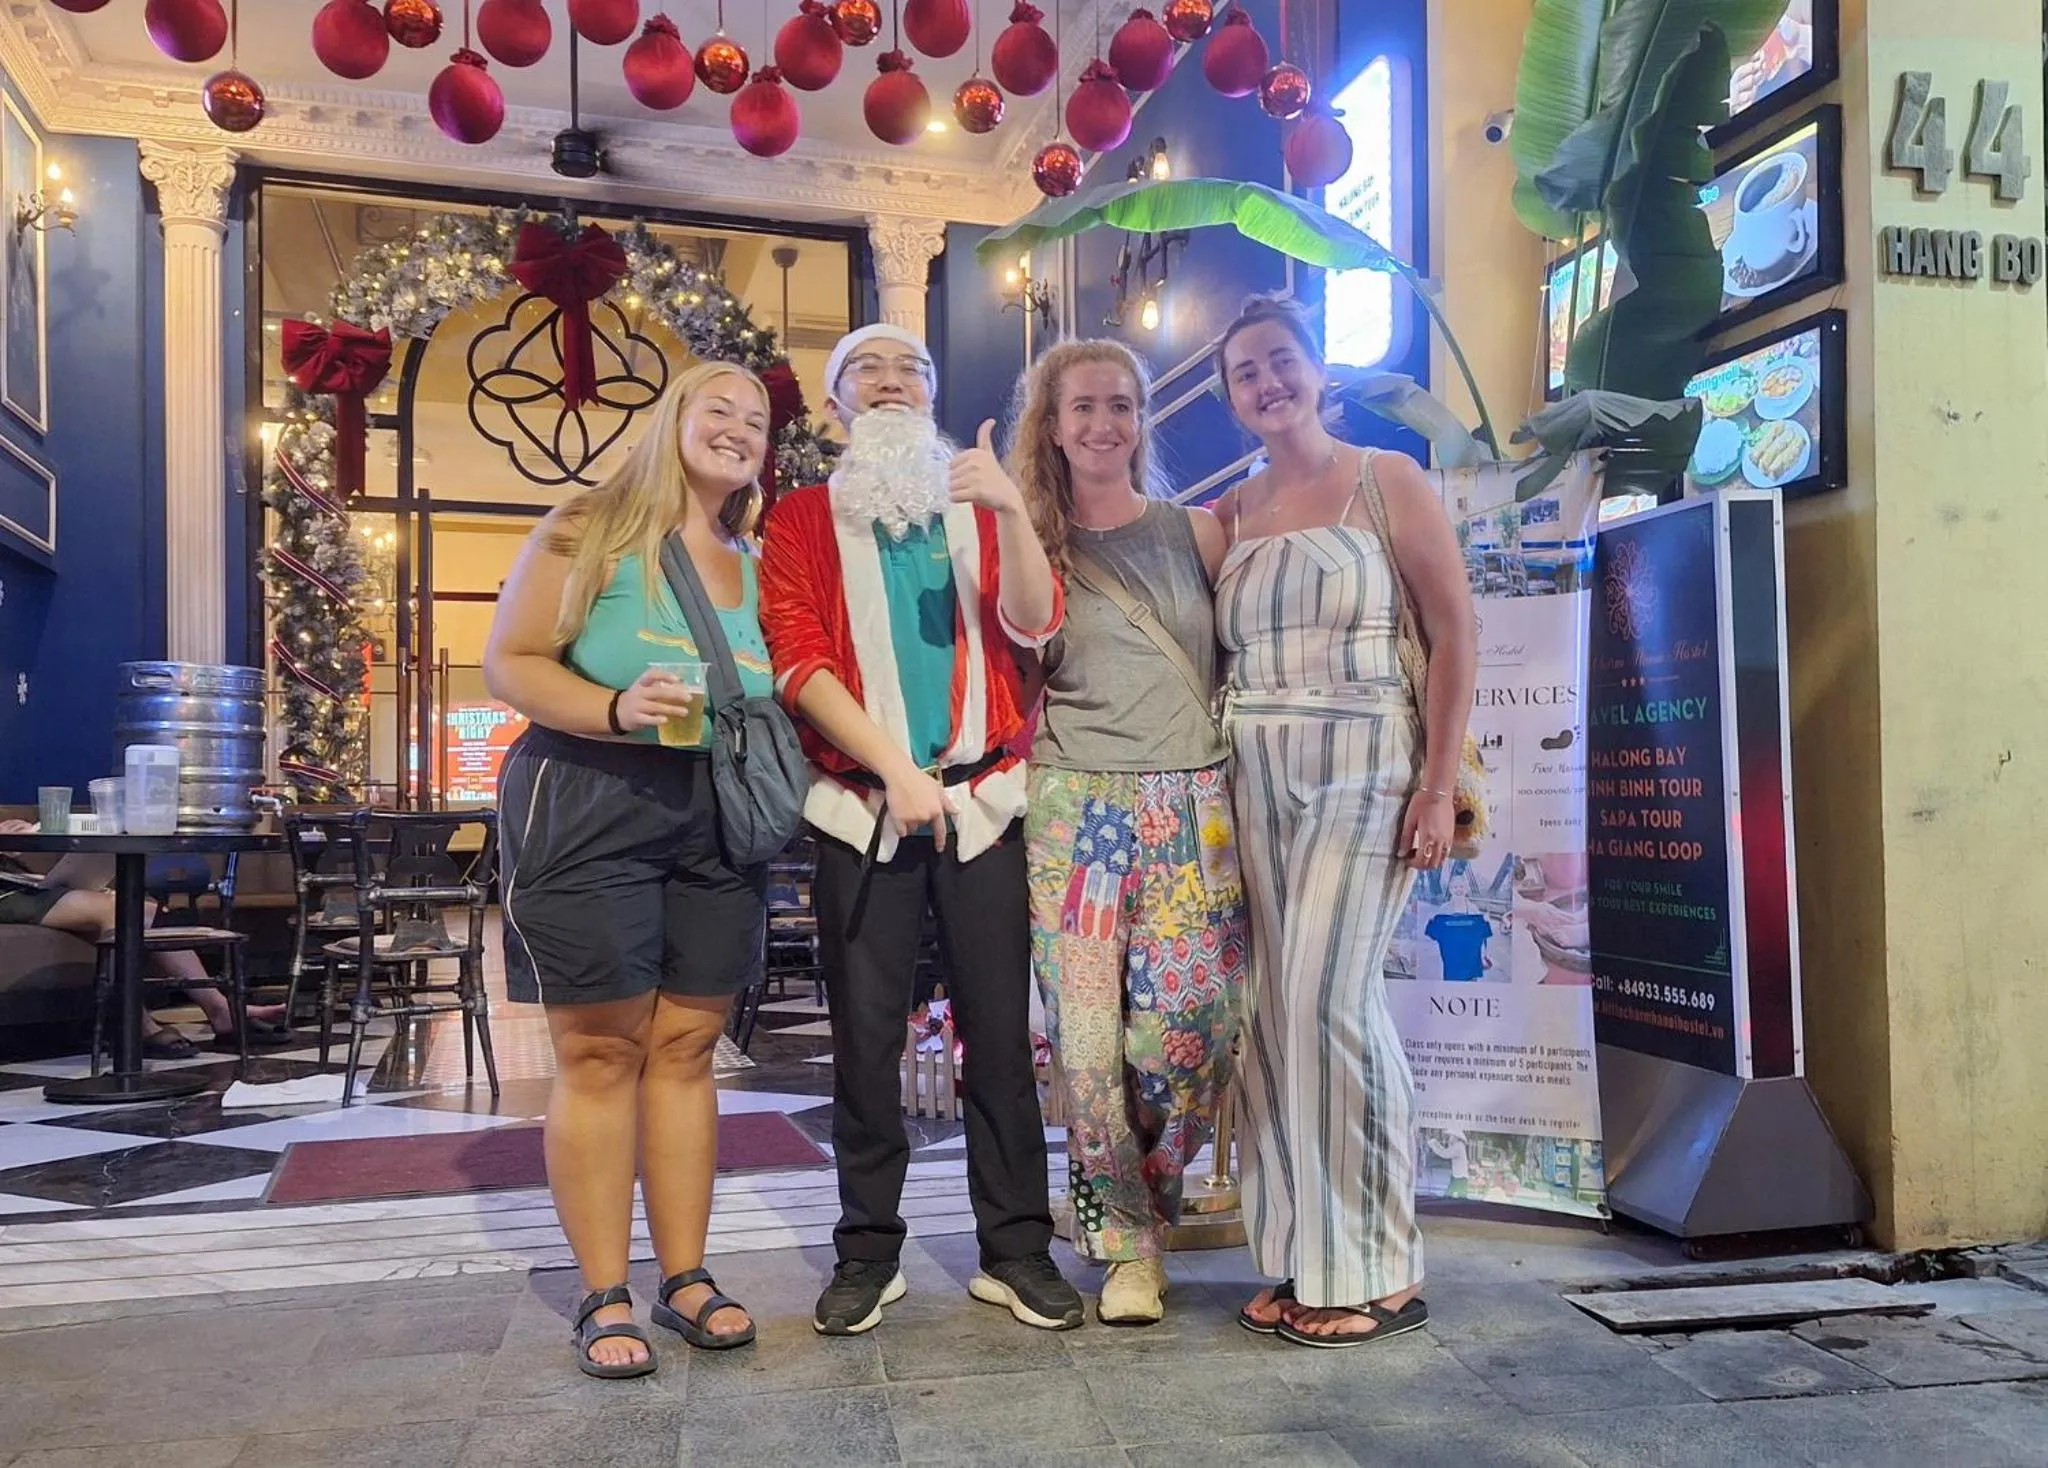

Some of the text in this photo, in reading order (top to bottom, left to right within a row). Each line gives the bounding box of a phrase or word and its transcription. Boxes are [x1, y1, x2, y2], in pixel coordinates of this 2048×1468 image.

[1891, 71, 2032, 202] 44
[1883, 226, 2043, 285] HANG BO
[1475, 685, 1578, 707] ERVICES
[1590, 696, 1708, 726] AVEL AGENCY
[1591, 745, 1687, 769] HALONG BAY
[1619, 778, 1655, 798] BINH
[1659, 777, 1702, 798] TOUR
[1600, 808, 1682, 829] SAPA TOUR
[1608, 840, 1655, 859] GIANG
[1659, 841, 1703, 862] LOOP
[1649, 900, 1717, 921] EXPERIENCES
[1618, 977, 1715, 1012] +84933.555.689
[1429, 995, 1501, 1018] NOTE
[1515, 1073, 1533, 1084] such
